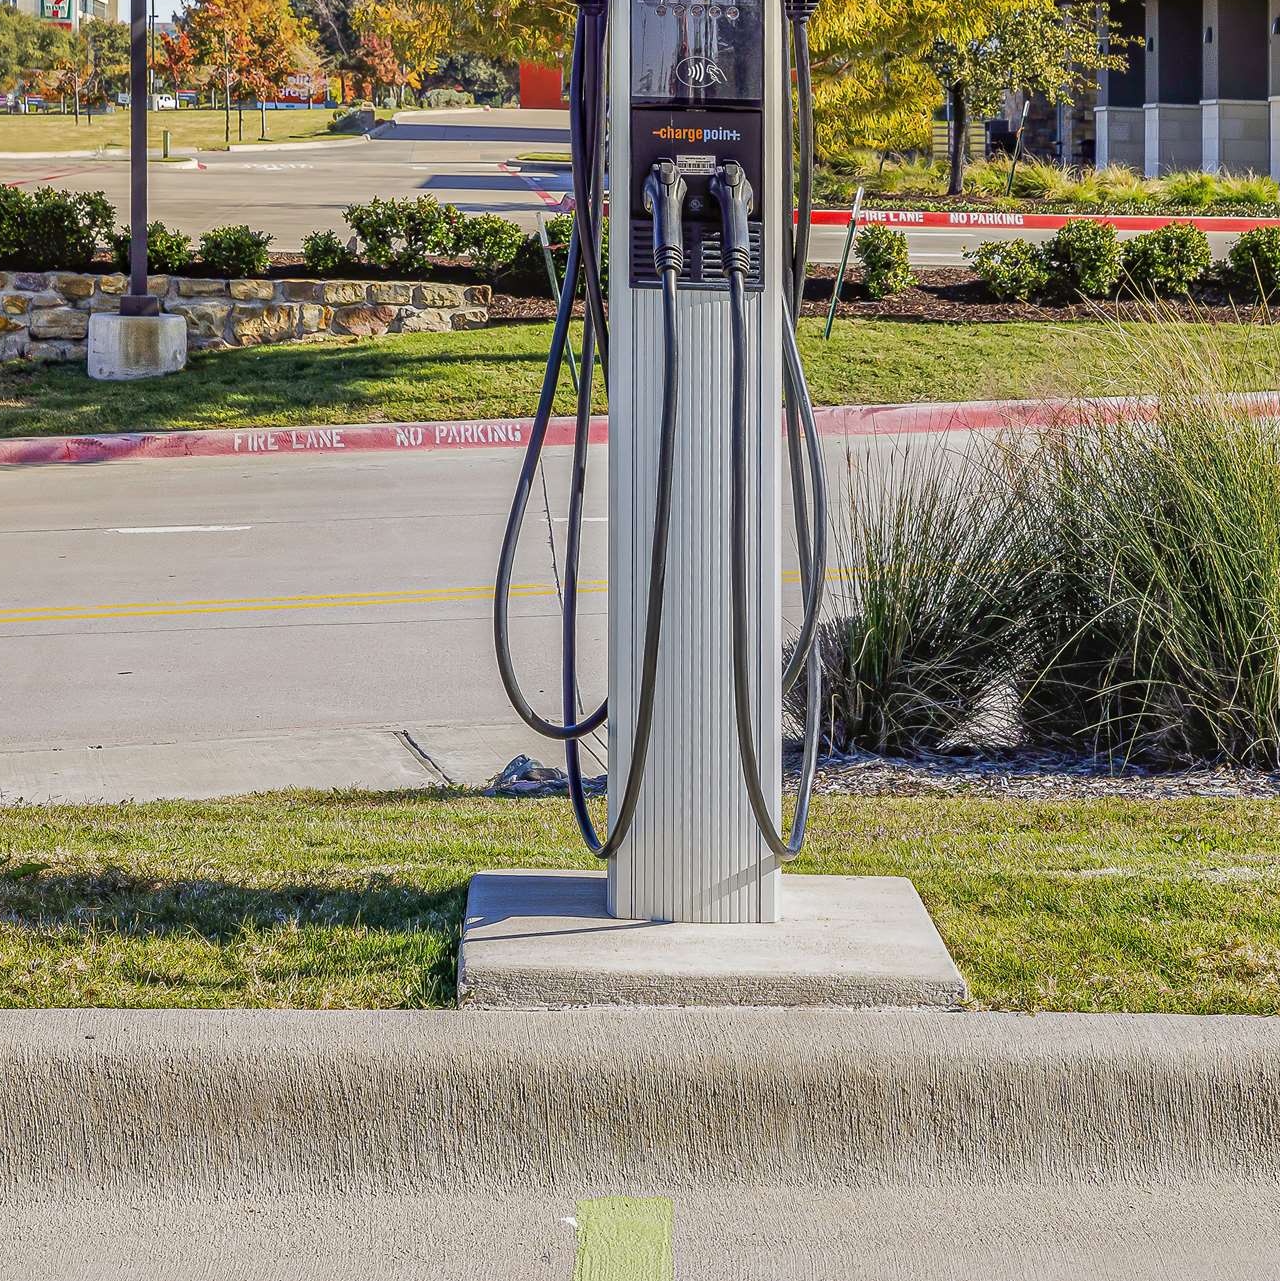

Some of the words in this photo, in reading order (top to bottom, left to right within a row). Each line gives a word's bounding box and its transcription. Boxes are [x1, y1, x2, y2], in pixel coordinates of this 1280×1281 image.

[858, 211, 886, 222] FIRE
[887, 212, 924, 223] LANE
[950, 212, 967, 224] NO
[970, 212, 1024, 225] PARKING
[233, 431, 278, 452] FIRE
[291, 429, 346, 449] LANE
[395, 426, 424, 447] NO
[434, 423, 522, 444] PARKING
